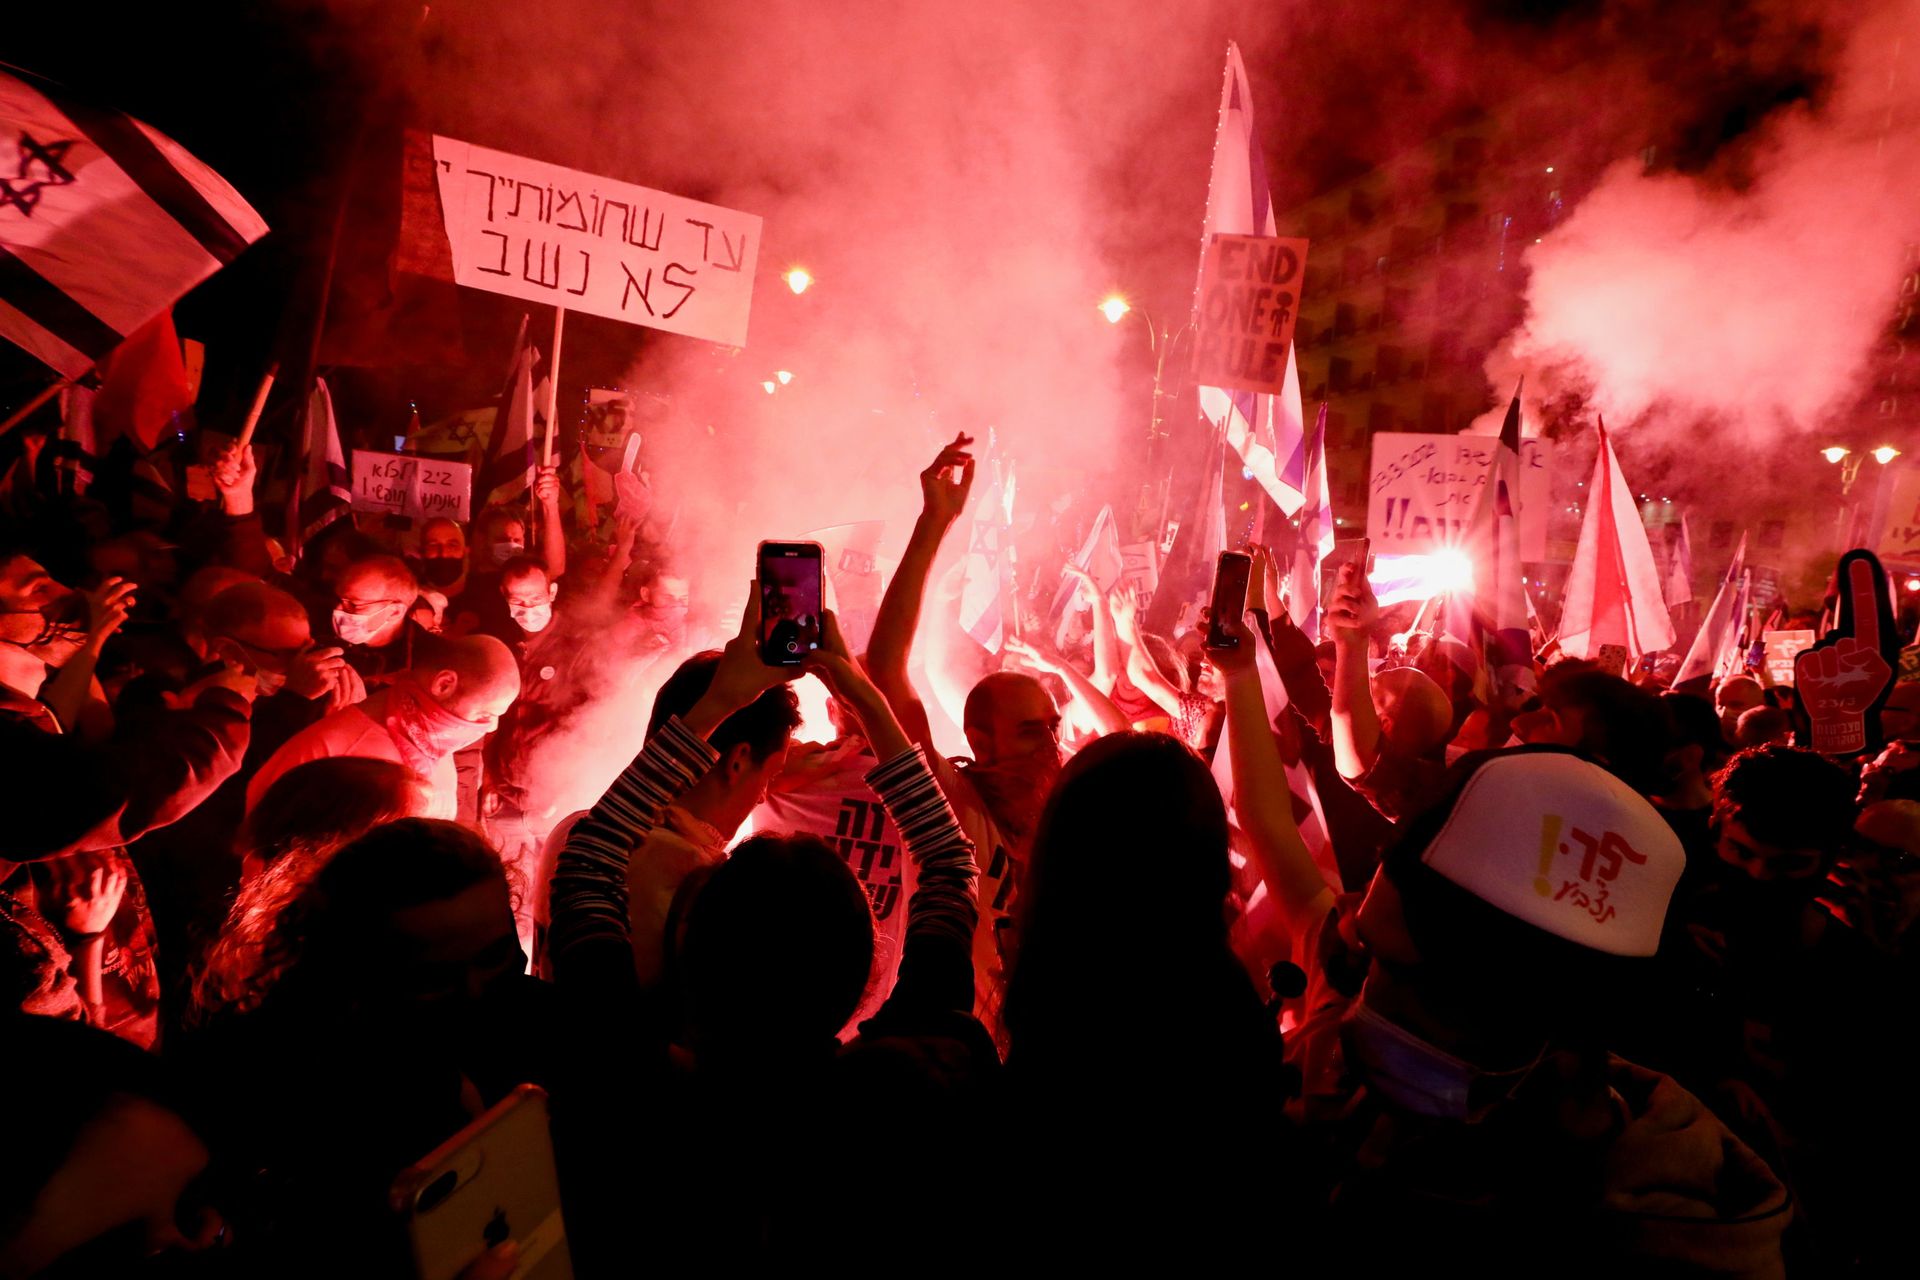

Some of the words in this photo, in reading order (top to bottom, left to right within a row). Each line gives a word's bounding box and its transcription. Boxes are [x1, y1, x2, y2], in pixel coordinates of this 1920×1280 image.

[477, 229, 590, 296] נשב
[686, 217, 746, 272] עד
[1218, 240, 1298, 285] END
[620, 261, 697, 319] לא
[1205, 284, 1273, 335] ONE
[1199, 330, 1285, 383] RULE
[1817, 697, 1856, 708] 23/3
